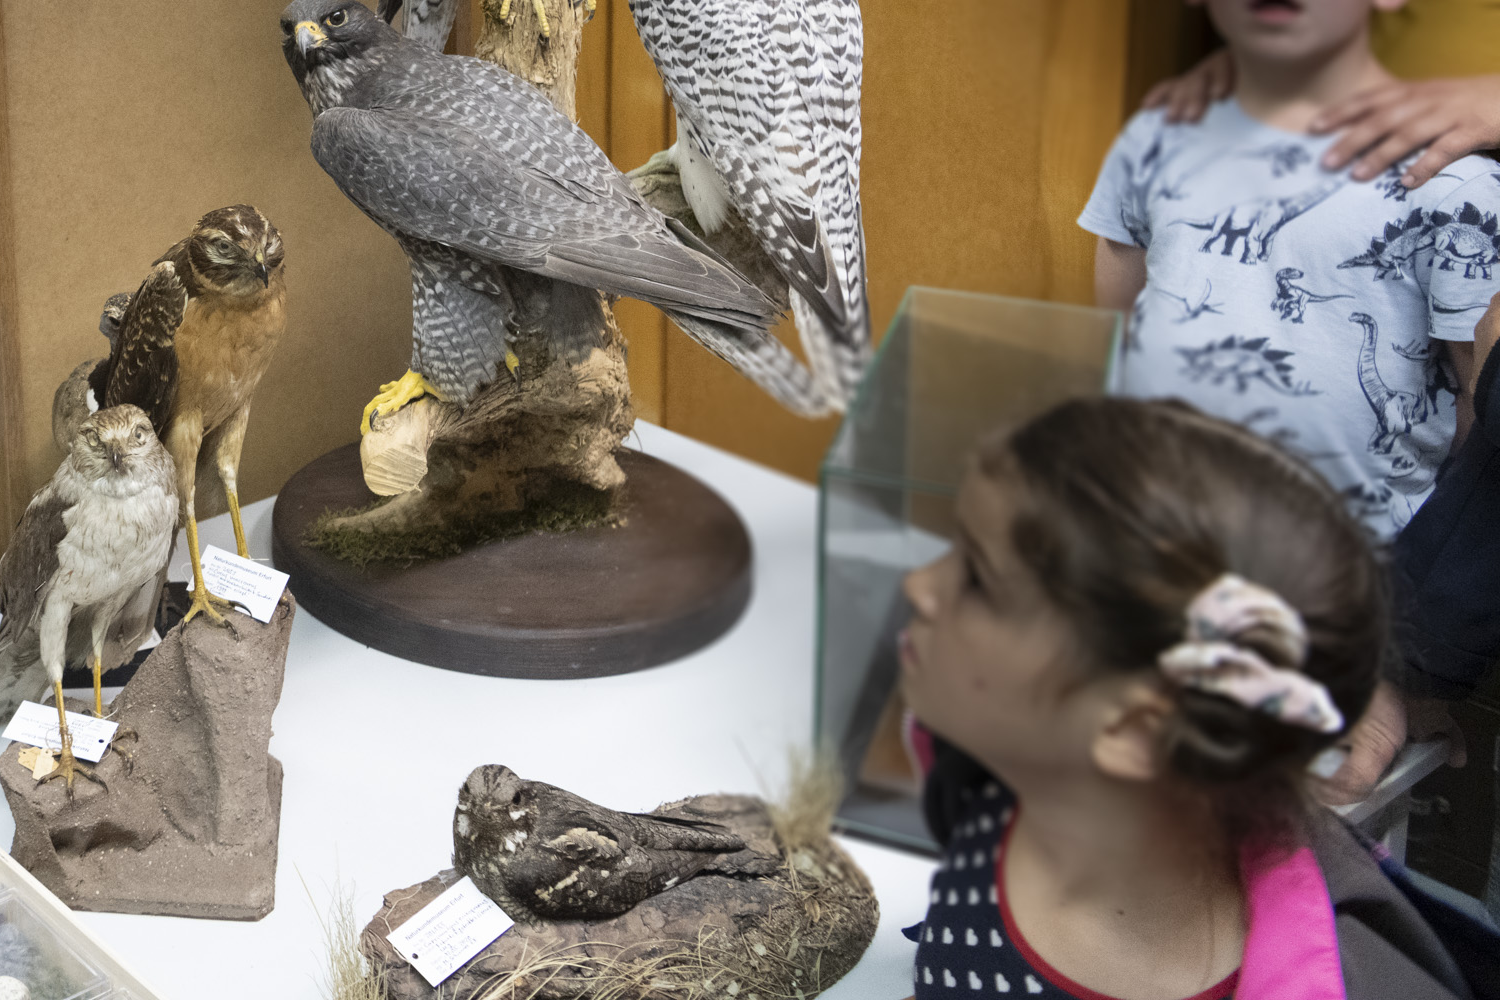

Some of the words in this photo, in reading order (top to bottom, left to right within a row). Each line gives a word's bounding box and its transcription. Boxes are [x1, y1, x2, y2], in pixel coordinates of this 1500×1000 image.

[213, 555, 258, 575] Naturkundemuseum
[258, 572, 272, 581] Erfurt
[404, 905, 451, 941] Naturkundemuseum
[449, 893, 464, 906] Erfurt
